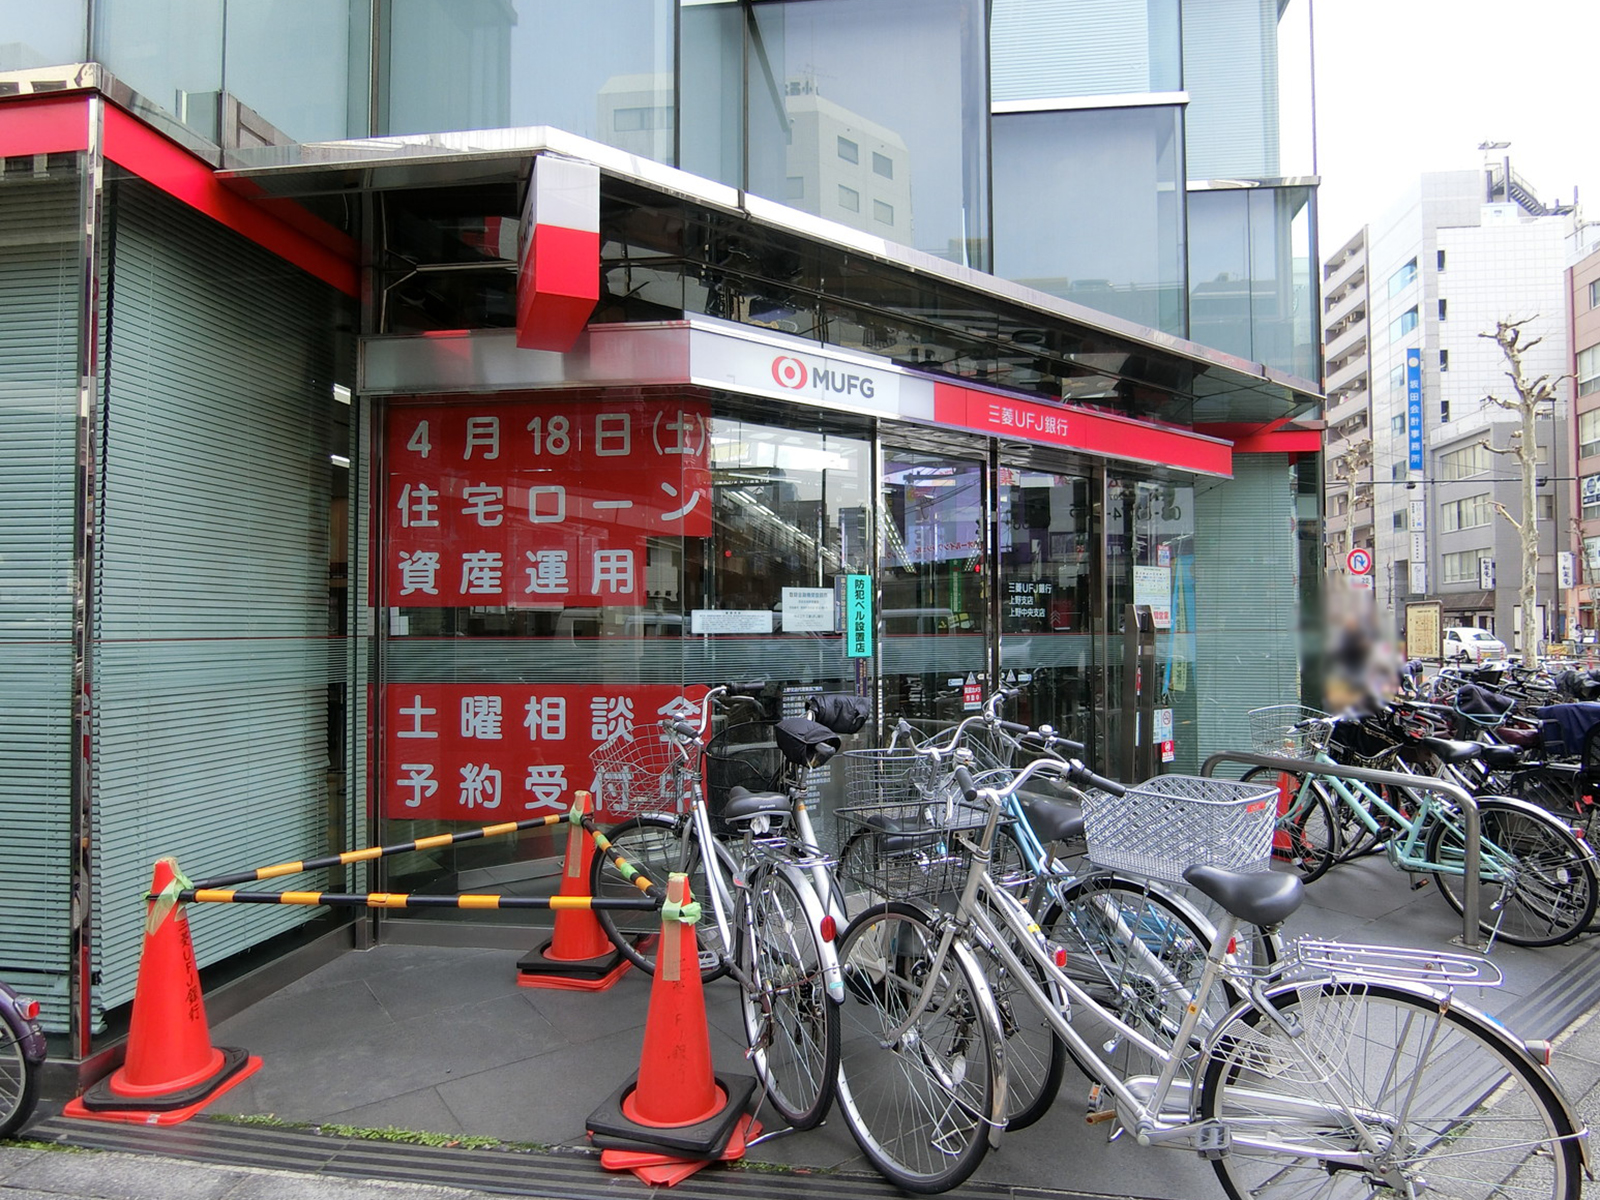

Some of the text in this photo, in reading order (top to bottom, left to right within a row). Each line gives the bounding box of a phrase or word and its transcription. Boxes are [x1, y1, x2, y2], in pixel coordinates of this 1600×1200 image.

[812, 367, 875, 399] MUFG
[406, 409, 705, 460] 4月18日(土)
[987, 404, 1069, 437] 三菱UFJ銀行
[397, 482, 701, 528] 住宅ローン
[397, 549, 635, 596] 資産運用
[1007, 582, 1053, 595] 三菱UFJ銀行
[854, 578, 866, 654] 防犯ベル設置店
[1008, 595, 1034, 606] 上野支店
[1008, 607, 1046, 619] 上野中央支店
